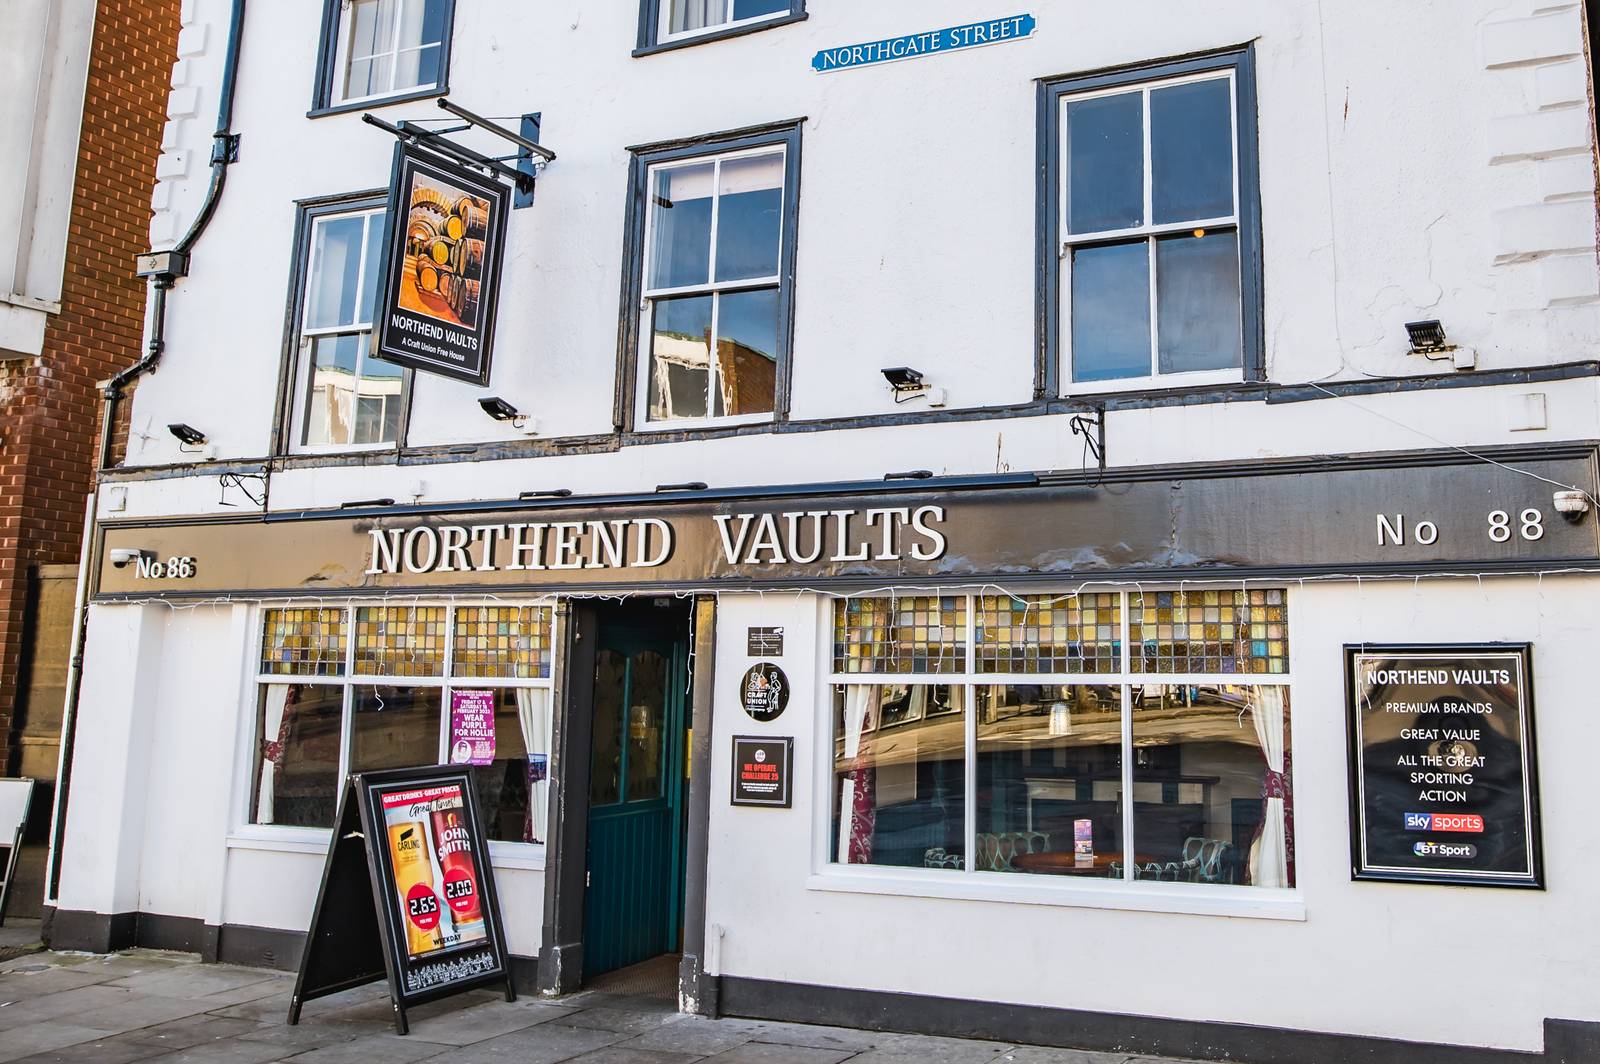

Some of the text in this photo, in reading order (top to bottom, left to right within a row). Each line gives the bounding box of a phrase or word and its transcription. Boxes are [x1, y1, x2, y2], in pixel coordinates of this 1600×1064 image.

[823, 18, 1024, 69] NORTHGATE STREET
[391, 314, 478, 350] NORTHEND VAULTS
[401, 337, 465, 362] A Craft Union Free House
[1376, 508, 1544, 546] No 88
[365, 504, 948, 575] NORTHEND VAULTS
[1367, 669, 1510, 685] NORTHEND VAULTS
[1386, 702, 1493, 714] PREMIUM BRANDS
[464, 714, 484, 722] WEAR
[454, 729, 494, 737] FOR HOLLIE
[1400, 729, 1480, 741] GREAT VALUE
[1397, 755, 1485, 767] ALL THE GREAT
[1410, 772, 1474, 785] SPORTING
[383, 794, 402, 803] GREAT
[402, 791, 423, 801] DRINKS
[1419, 790, 1467, 802] ACTION
[1407, 815, 1482, 830] sky sports
[440, 827, 470, 845] JOHN
[397, 840, 420, 851] CARLING
[438, 840, 471, 862] SMITH
[1421, 844, 1470, 856] BT Sport
[446, 880, 473, 899] 2.00
[409, 896, 437, 916] 2.65
[433, 934, 462, 946] WEEKDAY
